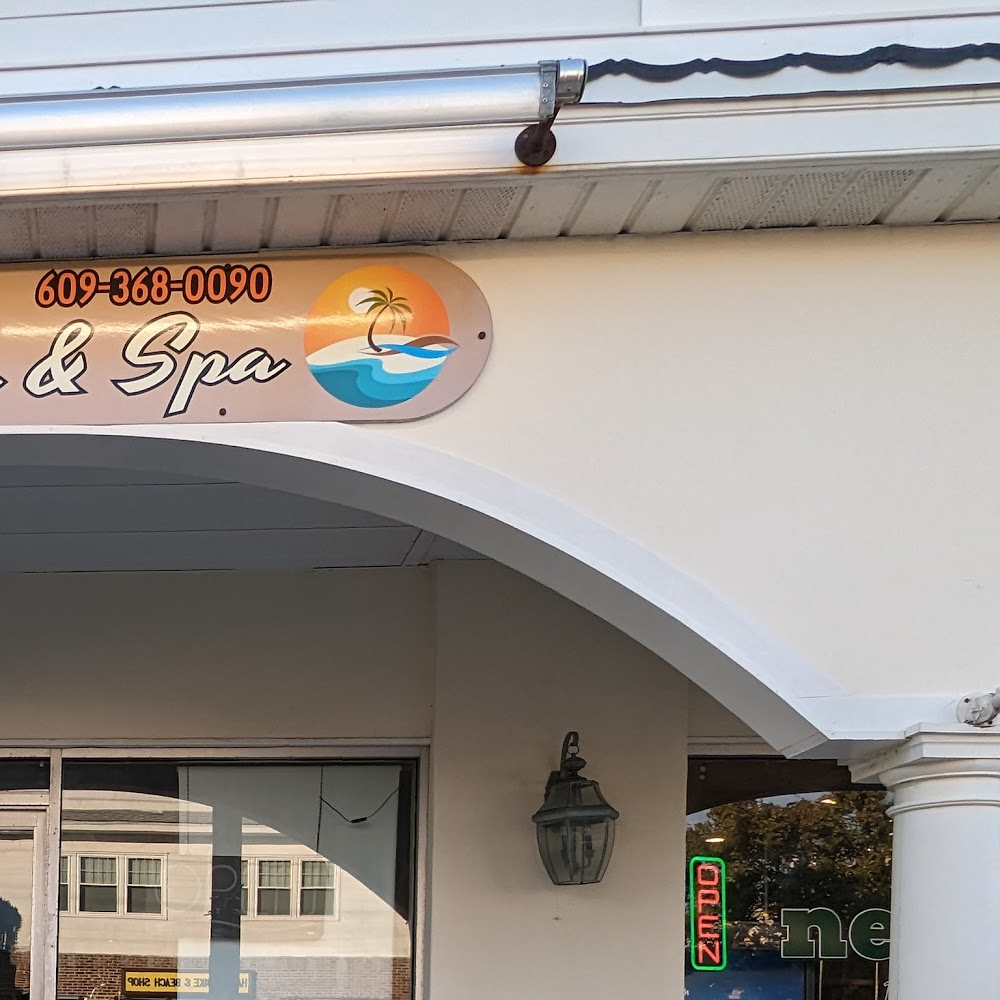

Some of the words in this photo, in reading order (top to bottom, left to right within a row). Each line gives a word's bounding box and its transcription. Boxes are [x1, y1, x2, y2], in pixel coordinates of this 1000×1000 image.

[34, 264, 272, 308] 609-368-0090
[22, 318, 95, 398] &
[111, 310, 291, 419] Spa
[696, 863, 721, 965] OPEN
[781, 907, 891, 960] ne
